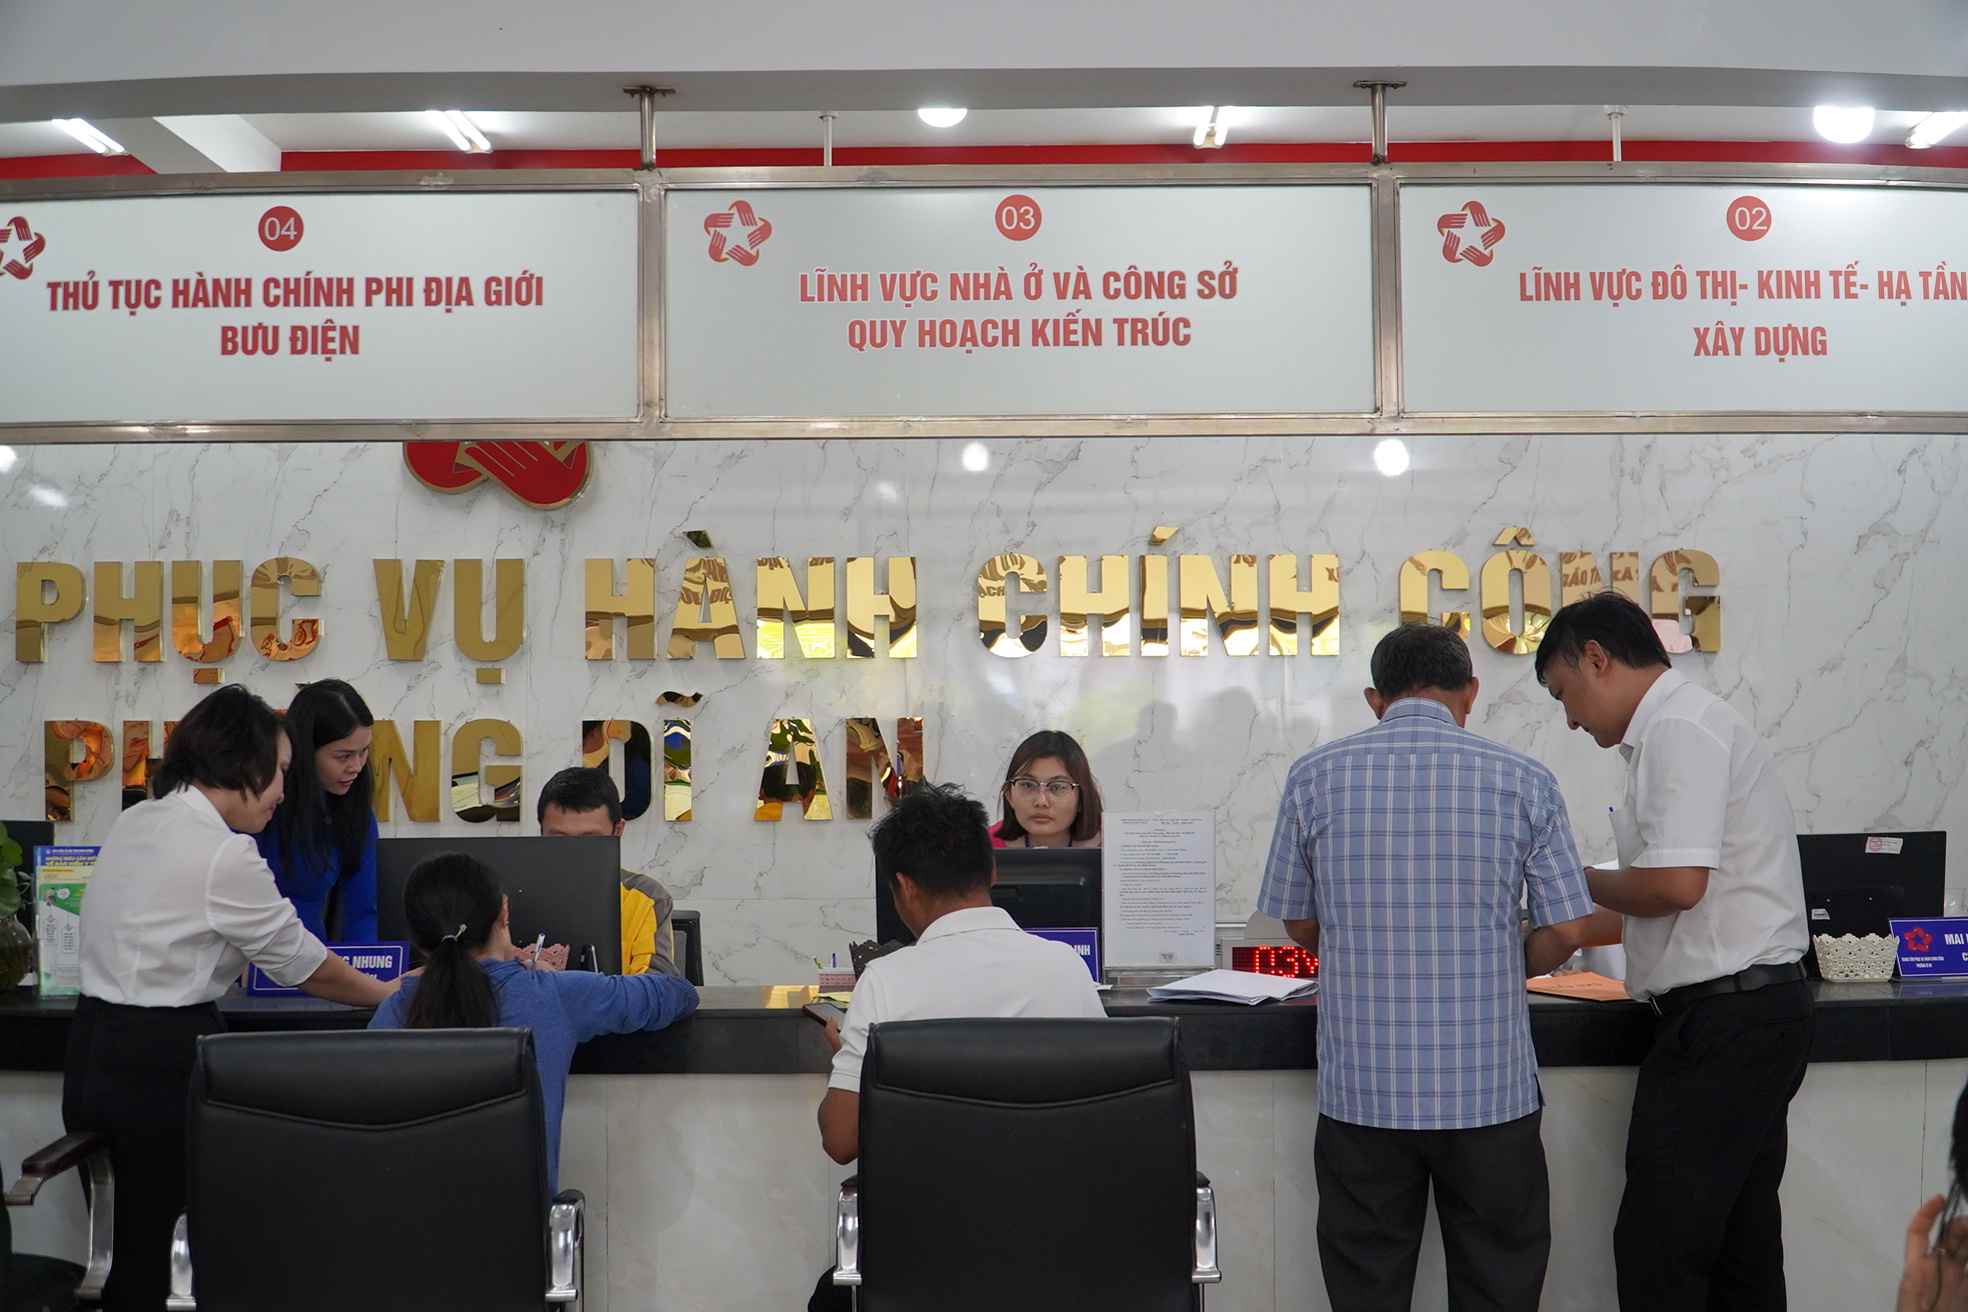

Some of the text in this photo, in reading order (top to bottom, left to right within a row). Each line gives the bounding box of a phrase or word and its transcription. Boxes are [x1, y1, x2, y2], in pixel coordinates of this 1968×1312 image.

[264, 216, 298, 241] 04
[1002, 205, 1036, 230] 03
[1735, 206, 1768, 230] 02
[47, 268, 544, 315] THỦ TỤC HÀNH CHÍNH PHI ĐỊA GIỚI
[799, 260, 1239, 308] LĨNH VỰC NHÀ Ở VÀ CÔNG SỞ
[1519, 260, 1968, 308] LĨNH VỰC ĐÔ THỊ- KINH TẾ- HẠ TẦN
[219, 318, 360, 362] BƯU ĐIỆN
[847, 308, 1192, 354] QUY HOẠCH KIẾN TRÚC
[1694, 321, 1829, 363] XÂY DỰNG
[15, 556, 323, 684] PHỤC
[373, 558, 525, 685] VỤ
[585, 530, 918, 661] HÀNH
[976, 525, 1341, 658] CHÍNH
[582, 690, 702, 822] DĨ
[753, 716, 925, 822] AN
[1944, 933, 1965, 945] MAI
[352, 955, 393, 969] NHUNG
